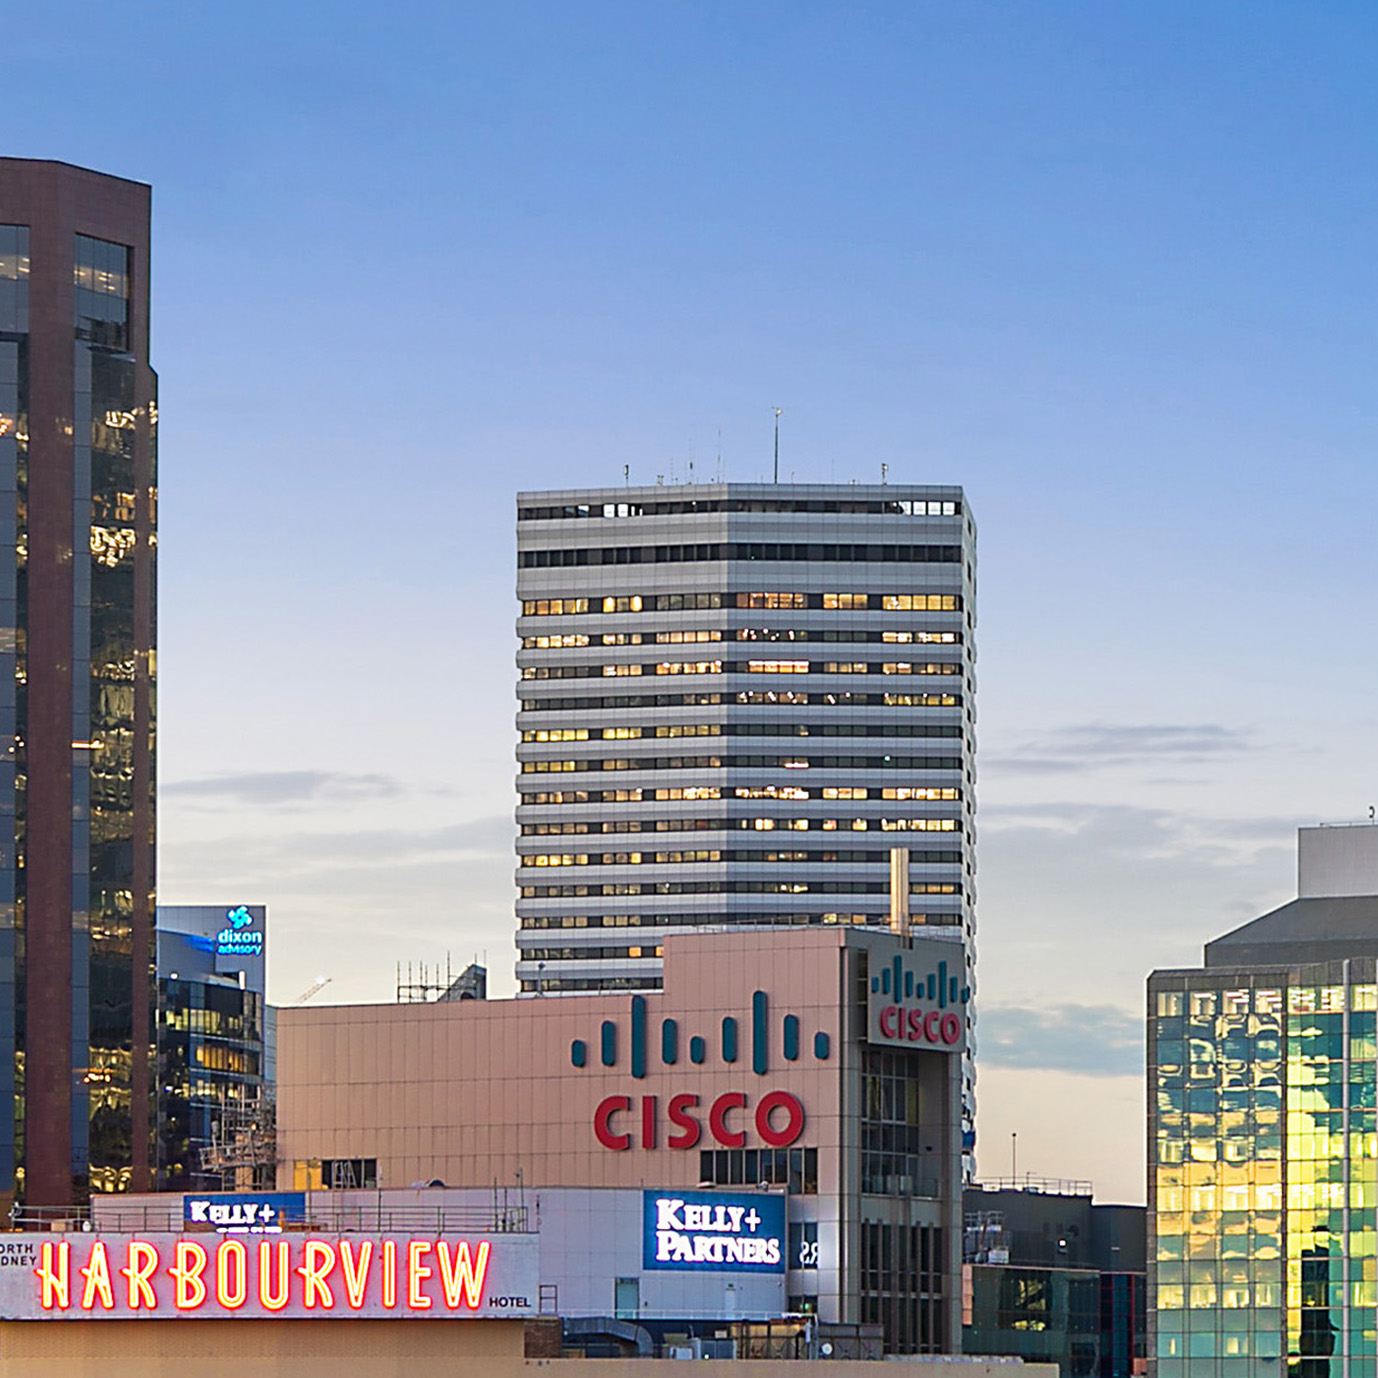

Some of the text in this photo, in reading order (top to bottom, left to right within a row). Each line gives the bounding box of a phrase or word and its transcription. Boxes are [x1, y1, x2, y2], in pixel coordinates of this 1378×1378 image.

[217, 929, 263, 943] dixon
[880, 1005, 961, 1046] CISCO
[594, 1090, 804, 1150] CISCO
[655, 1231, 781, 1264] PARTNERS
[36, 1239, 492, 1309] HARBOURVIEW
[489, 1296, 531, 1308] HOTEL
